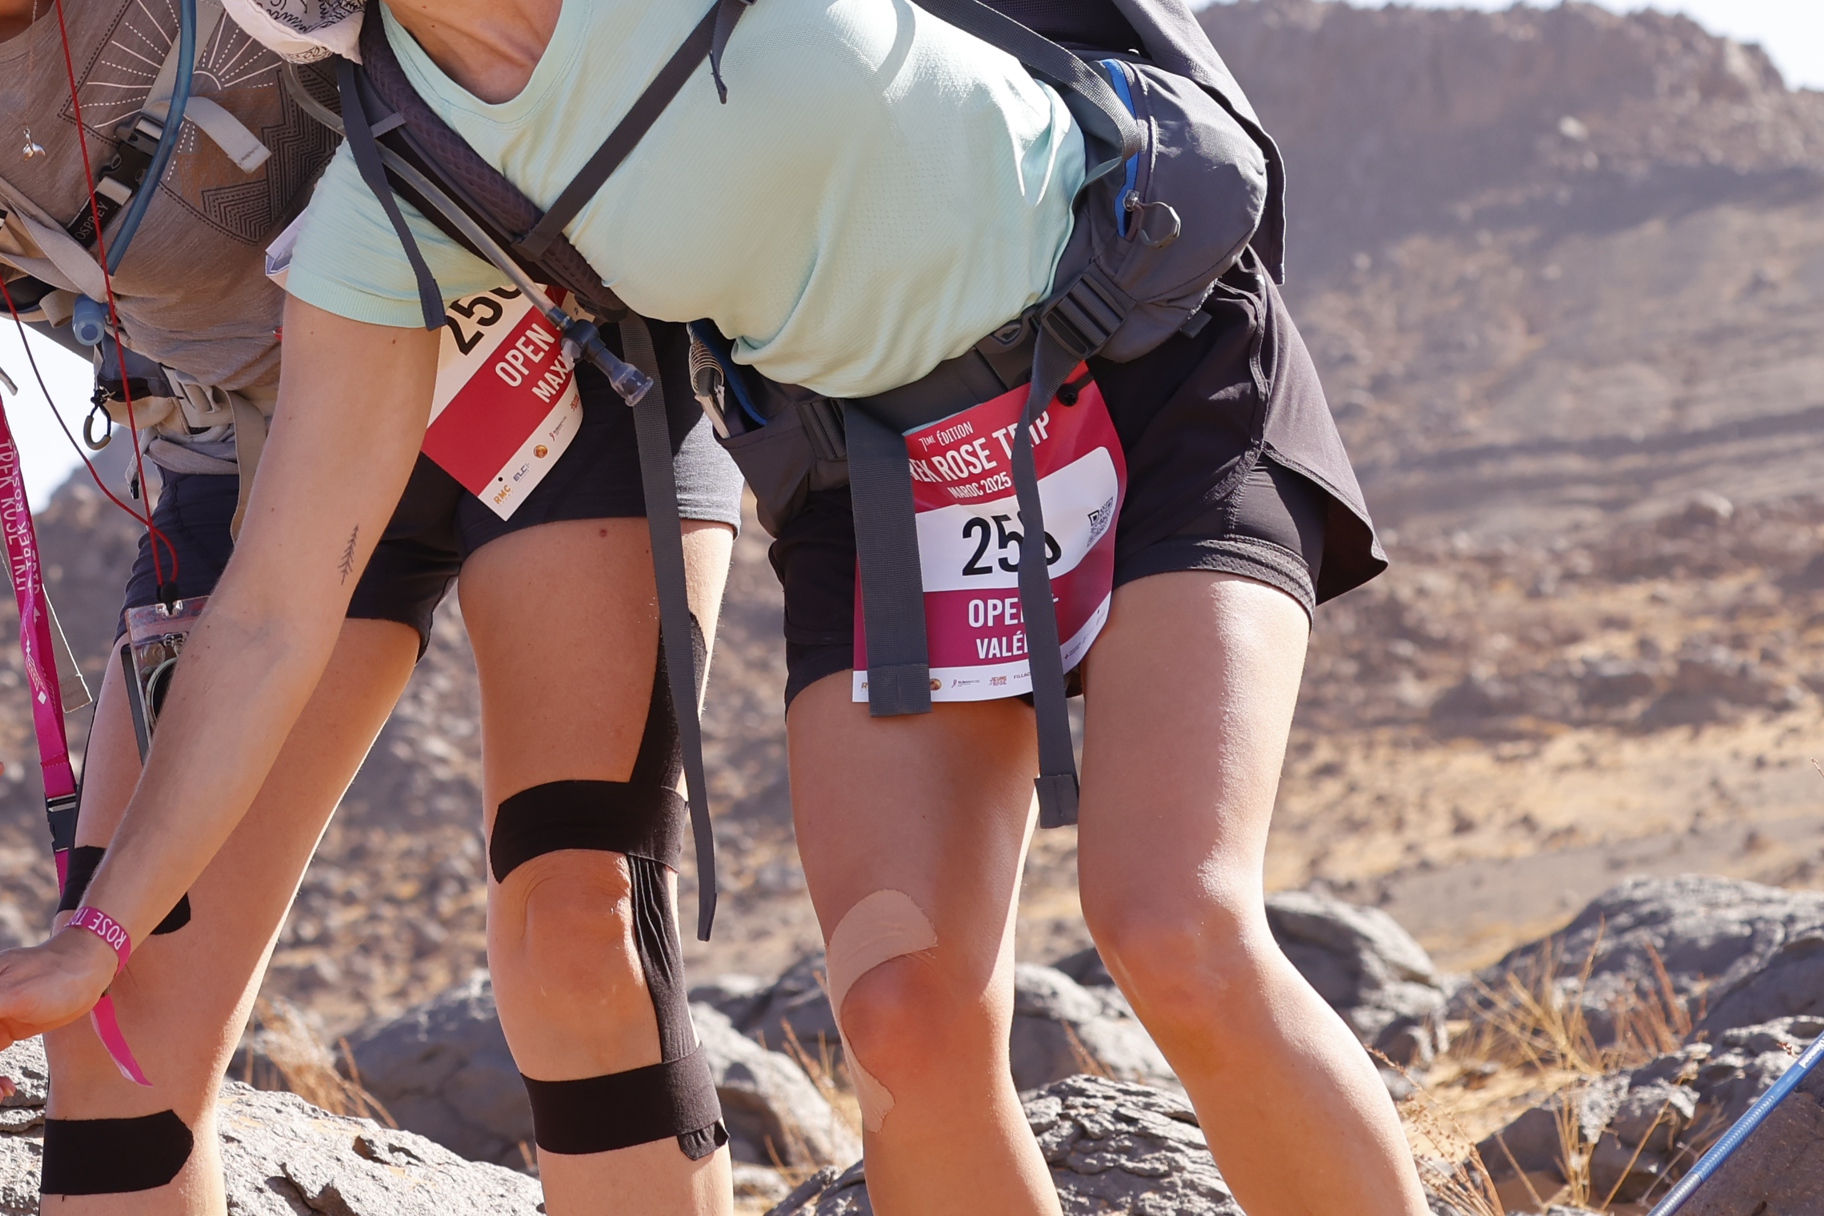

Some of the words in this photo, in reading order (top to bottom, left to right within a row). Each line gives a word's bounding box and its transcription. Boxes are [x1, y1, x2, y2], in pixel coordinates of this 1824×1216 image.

[495, 323, 555, 387] OPEN
[936, 421, 974, 446] ÉDITION
[910, 455, 942, 483] REK
[932, 437, 997, 483] ROSE
[493, 485, 511, 504] RMC
[948, 481, 984, 499] MAROC
[984, 471, 1012, 494] 2025
[968, 598, 1025, 628] OPE
[88, 912, 127, 951] ROSE
